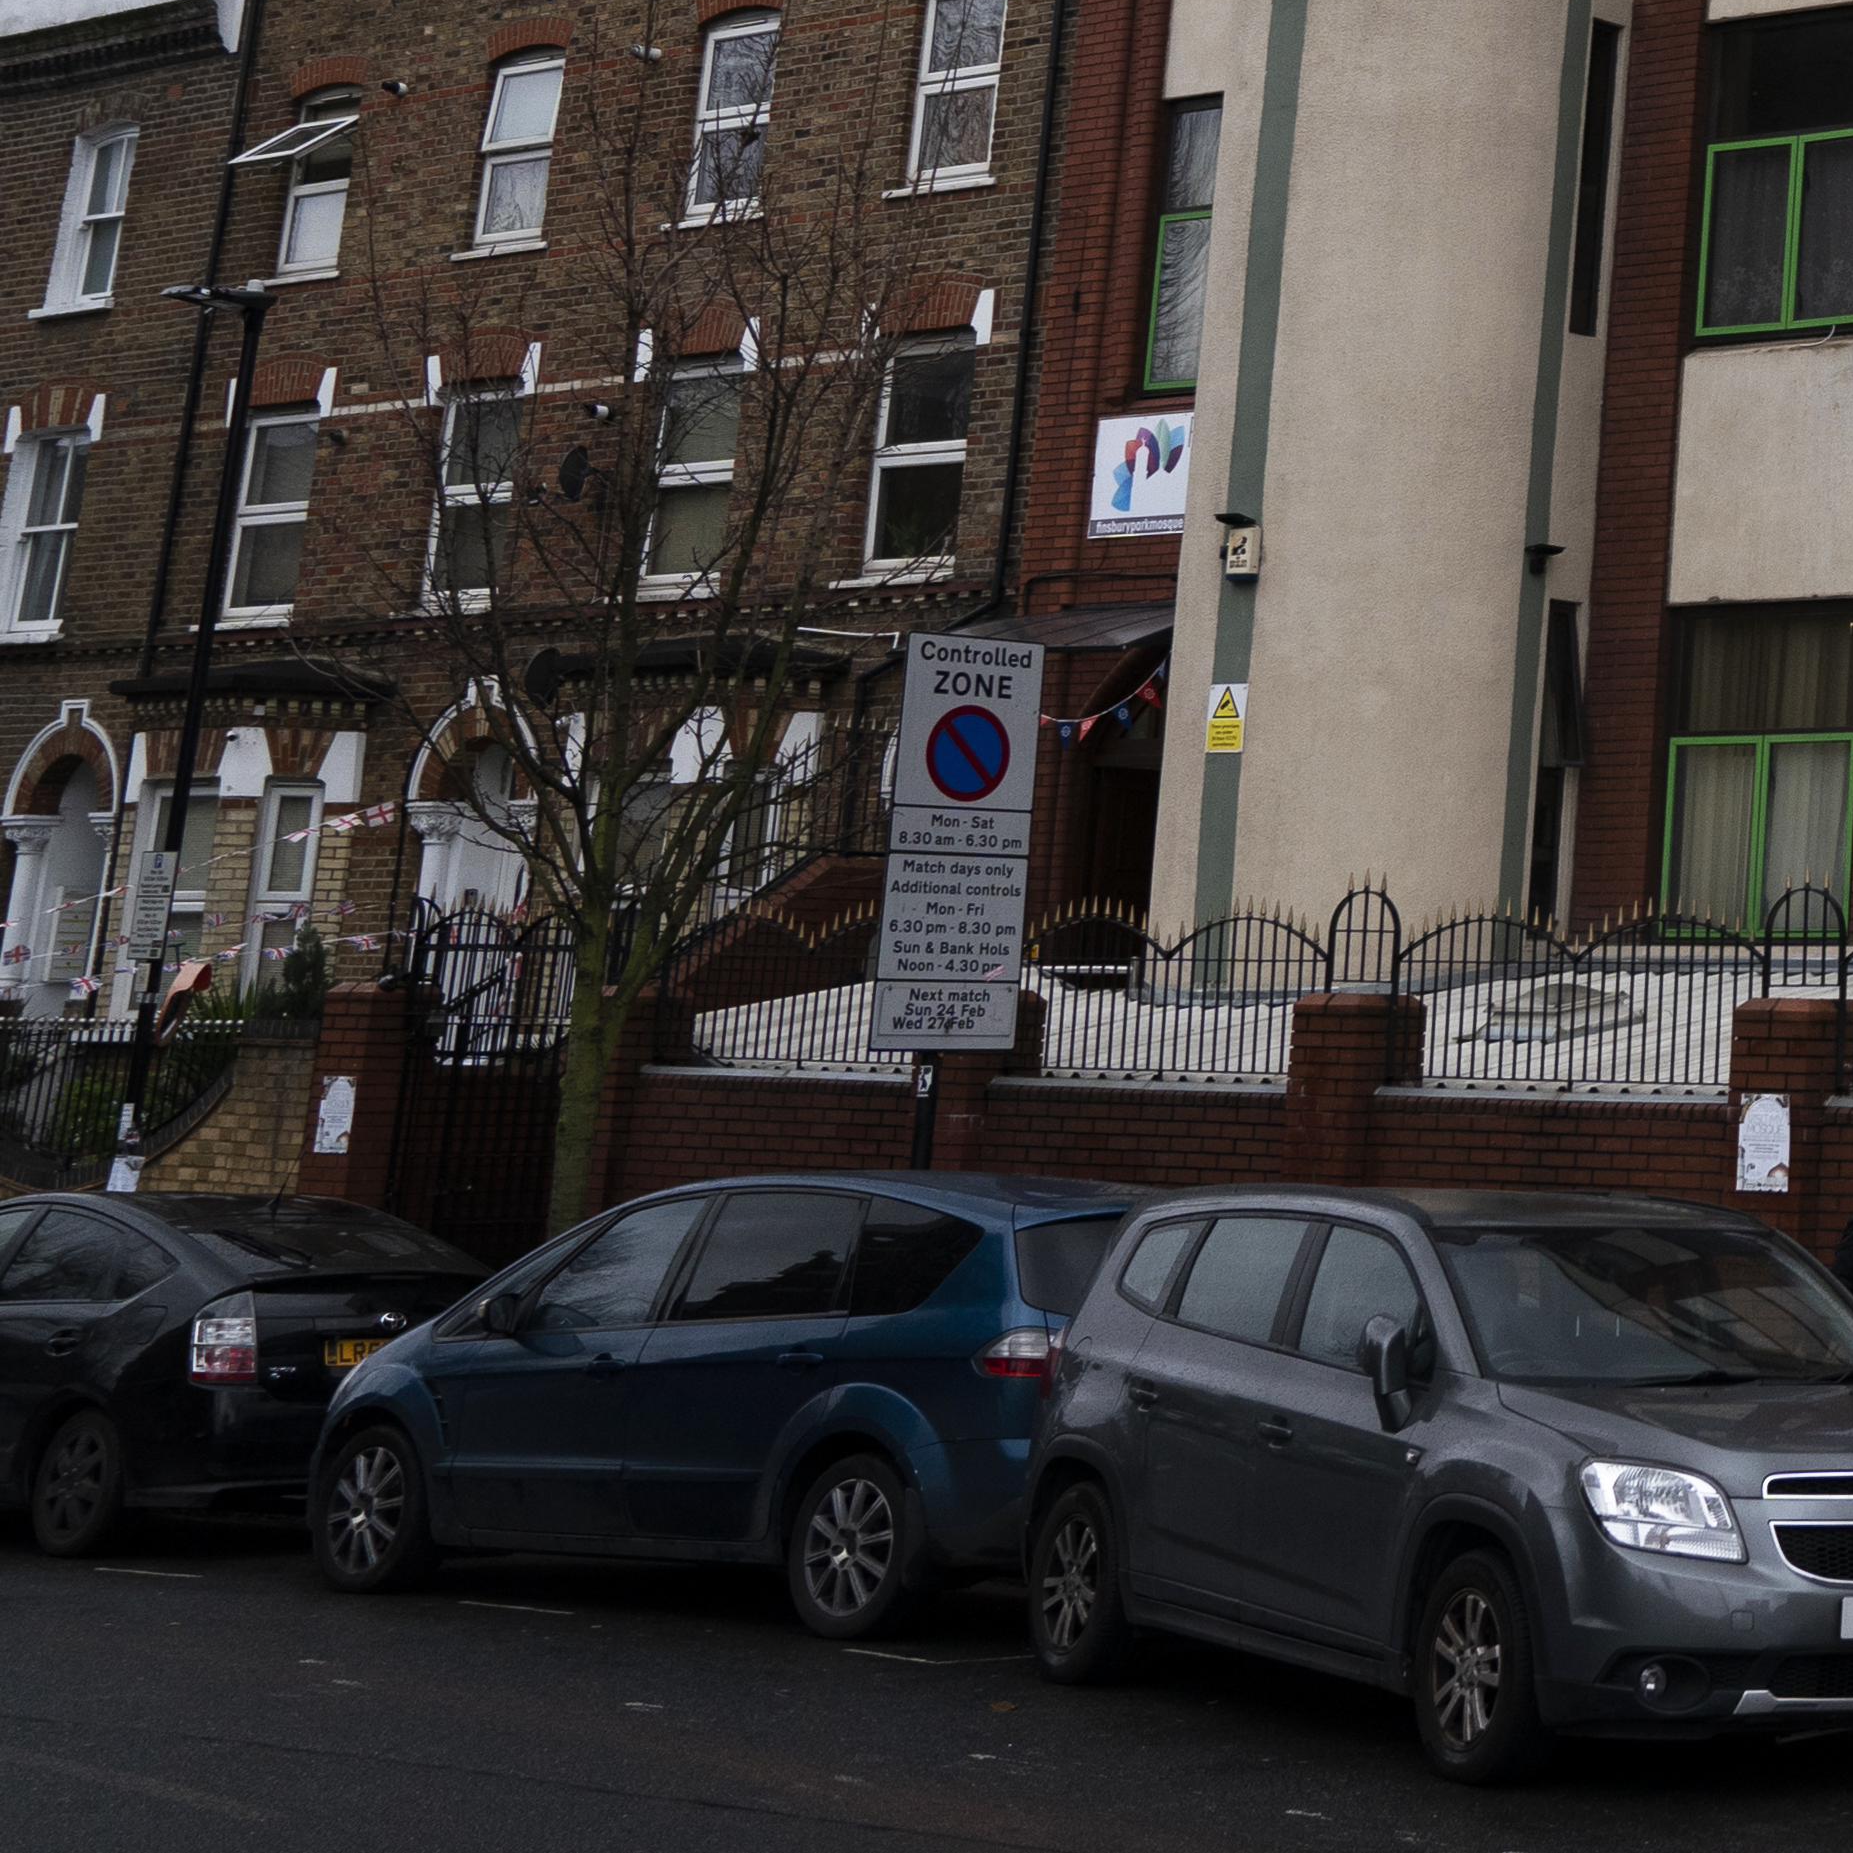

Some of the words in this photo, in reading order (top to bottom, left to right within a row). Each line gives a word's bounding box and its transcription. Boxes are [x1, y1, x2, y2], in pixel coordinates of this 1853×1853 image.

[921, 640, 1033, 669] Controlled
[934, 670, 1013, 699] ZONE
[931, 814, 960, 827] Mon
[971, 816, 995, 829] Sat
[898, 831, 932, 845] 8.30
[935, 836, 955, 846] am
[966, 834, 998, 848] 6.30
[1002, 838, 1022, 850] pm
[902, 859, 946, 874] Match
[950, 862, 981, 877] days
[985, 863, 1014, 878] only
[890, 880, 962, 894] Additional
[965, 884, 1022, 897] controls
[926, 902, 955, 915] Mon
[966, 903, 985, 916] Fri
[889, 919, 923, 933] 6.30
[925, 924, 947, 935] pm
[958, 921, 991, 935] 8.30
[996, 925, 1016, 937] pm
[892, 940, 920, 954] Sun
[925, 941, 934, 954] &
[940, 941, 975, 955] Bank
[980, 943, 1010, 956] Hols
[897, 959, 934, 971] Noon
[945, 959, 979, 972] 4.30
[909, 989, 943, 1002] Next
[948, 989, 991, 1002] match
[904, 1003, 932, 1016] Sun
[937, 1004, 955, 1016] 24
[961, 1004, 986, 1017] Feb
[892, 1016, 923, 1029] Wed
[927, 1016, 946, 1029] 27
[951, 1016, 975, 1029] Feb
